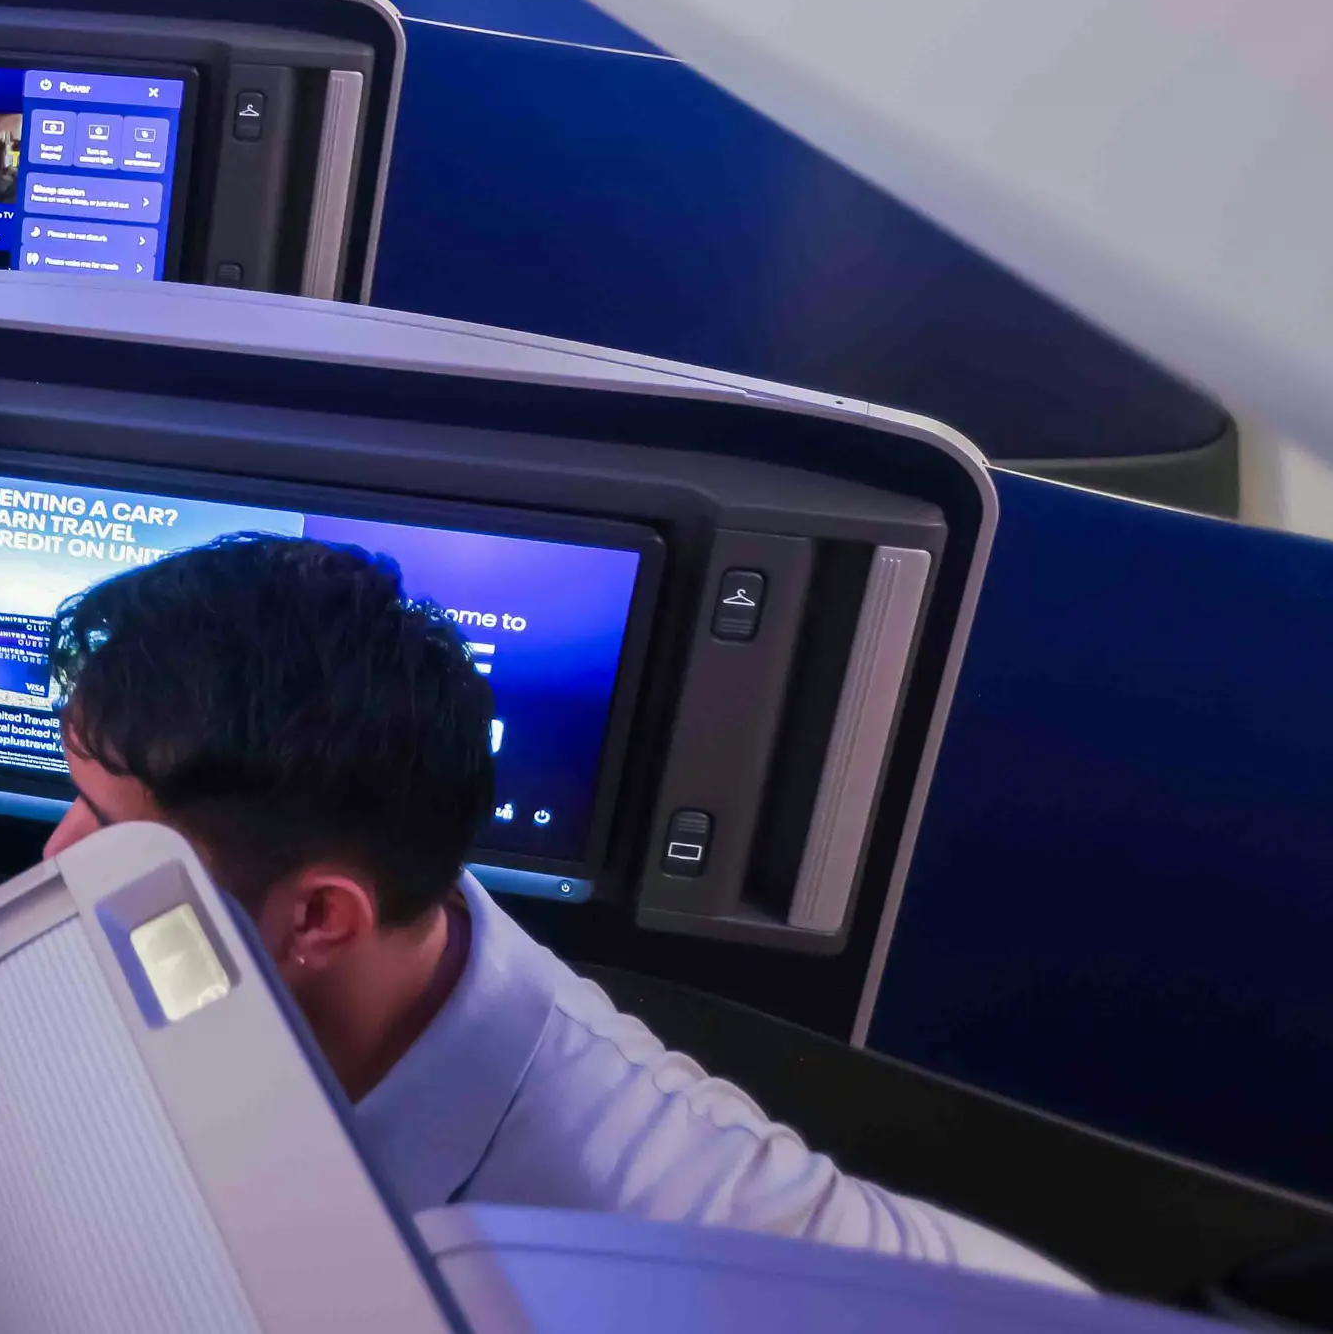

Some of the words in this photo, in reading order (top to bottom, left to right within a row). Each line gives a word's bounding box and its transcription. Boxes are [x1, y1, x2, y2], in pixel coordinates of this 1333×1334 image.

[59, 81, 91, 94] Power
[3, 211, 14, 220] TV
[89, 499, 109, 520] A
[111, 502, 179, 527] CAR?
[50, 515, 136, 544] TRAVEL
[67, 538, 105, 560] ON
[108, 543, 172, 566] UNIT
[0, 615, 28, 625] UNITED
[501, 612, 527, 632] to
[25, 682, 46, 692] VISA
[11, 724, 51, 739] booked
